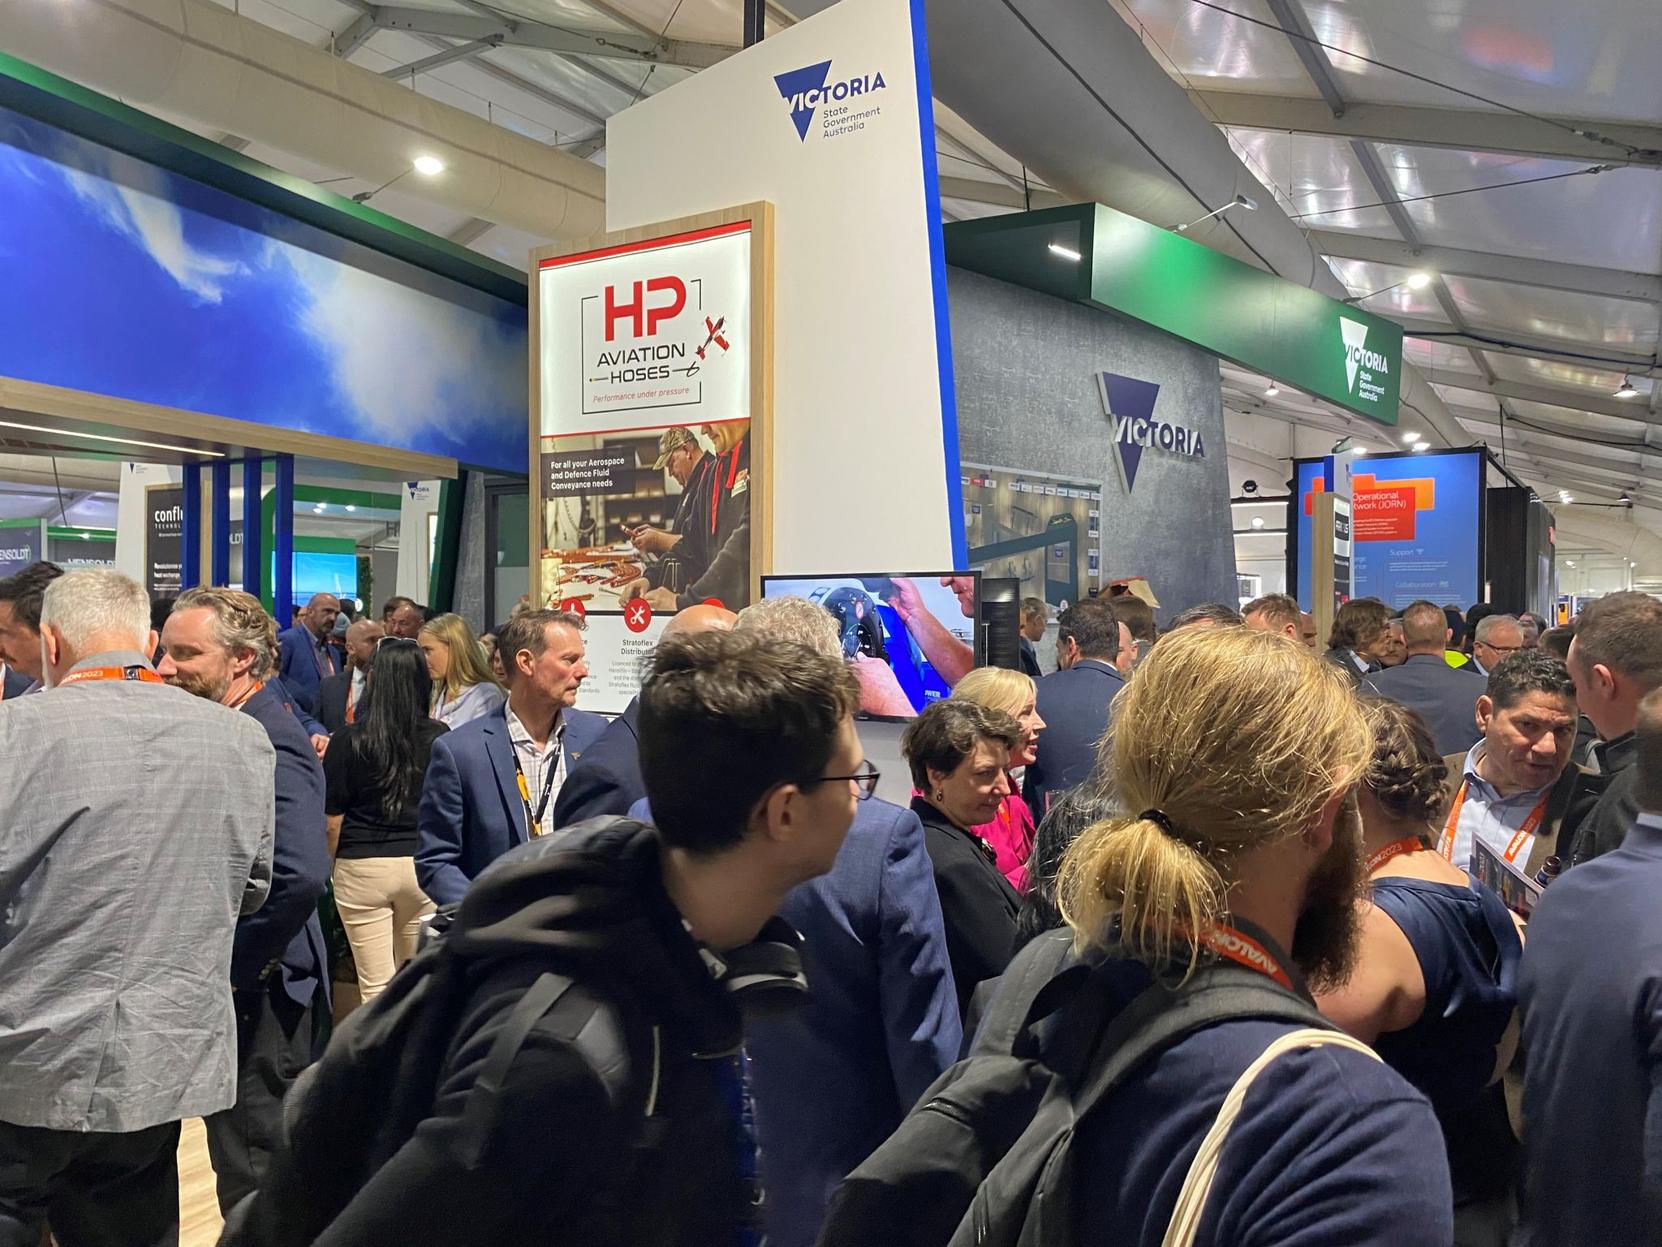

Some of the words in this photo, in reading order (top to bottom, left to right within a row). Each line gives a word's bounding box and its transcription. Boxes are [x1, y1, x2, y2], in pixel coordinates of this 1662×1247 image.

[785, 71, 886, 114] VICTORIA
[823, 106, 848, 118] State
[823, 106, 881, 128] Government
[823, 122, 865, 138] Australia
[604, 275, 687, 342] HP
[596, 343, 686, 367] AVIATION
[1343, 342, 1388, 374] VICTORIA
[610, 365, 670, 384] HOSES
[593, 393, 636, 403] Performance
[637, 390, 657, 399] under
[658, 387, 690, 397] pressure
[1110, 413, 1206, 458] VICTORIA
[550, 461, 562, 469] For
[562, 460, 571, 468] all
[572, 460, 588, 469] your
[588, 458, 625, 467] Aerospace
[550, 471, 563, 480] and
[564, 470, 592, 479] Defence
[593, 468, 610, 477] Fluid
[551, 481, 591, 491] Conveyance
[592, 479, 613, 488] needs
